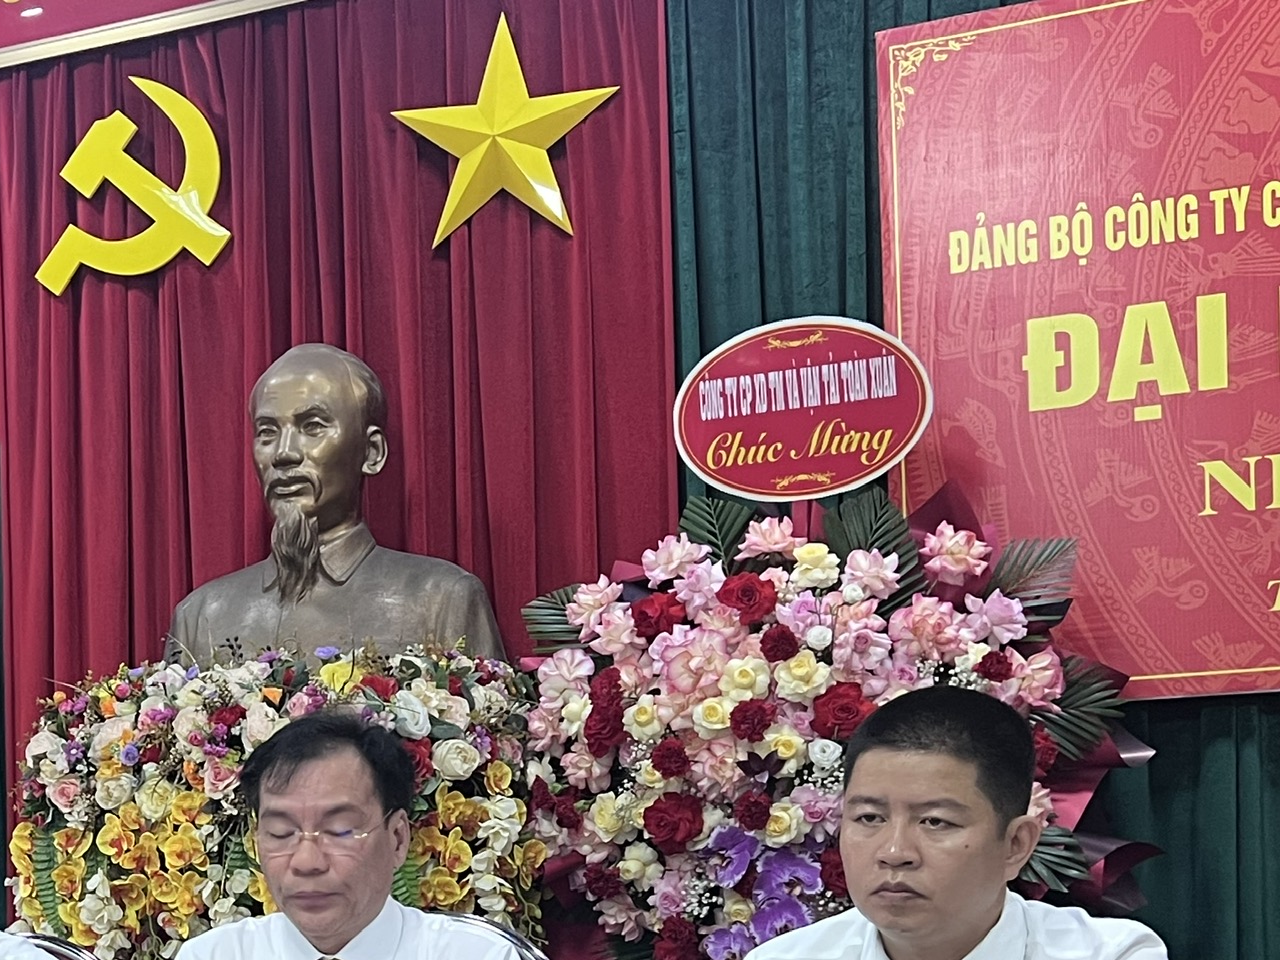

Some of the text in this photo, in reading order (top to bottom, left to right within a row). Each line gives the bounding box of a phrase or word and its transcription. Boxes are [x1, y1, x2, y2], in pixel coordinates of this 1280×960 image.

[948, 211, 1039, 275] ĐẢNG
[1049, 202, 1094, 266] BỘ
[1104, 192, 1200, 252] CÔNG
[1209, 185, 1251, 235] TY
[699, 372, 724, 421] CÔNG
[725, 377, 738, 417] TY
[739, 375, 752, 416] CP
[785, 358, 800, 409] VÀ
[1021, 292, 1229, 422] ĐẠI
[706, 418, 897, 470] Chúc Mừng
